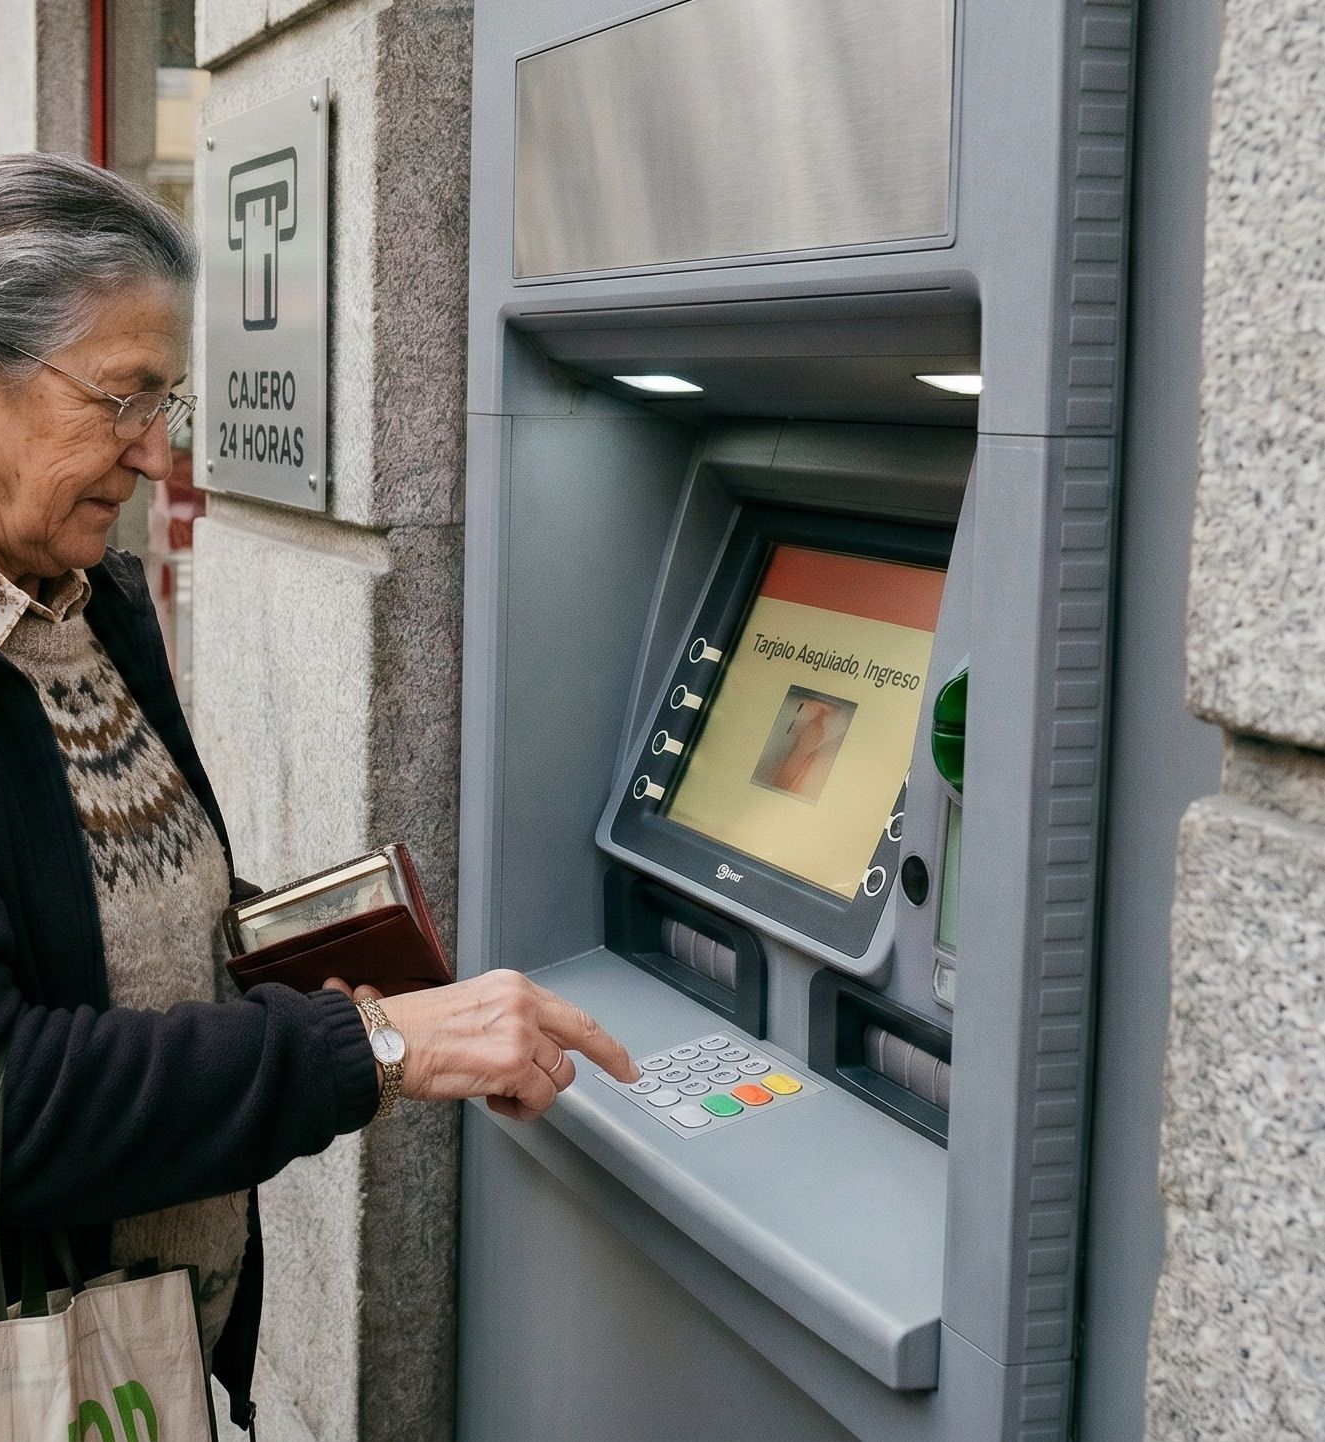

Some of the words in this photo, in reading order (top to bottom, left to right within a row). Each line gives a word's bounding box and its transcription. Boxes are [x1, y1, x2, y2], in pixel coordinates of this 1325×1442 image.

[228, 370, 296, 411] CAJERO
[219, 421, 238, 460] 24
[242, 423, 304, 468] HORAS
[863, 658, 920, 690] Ingreso
